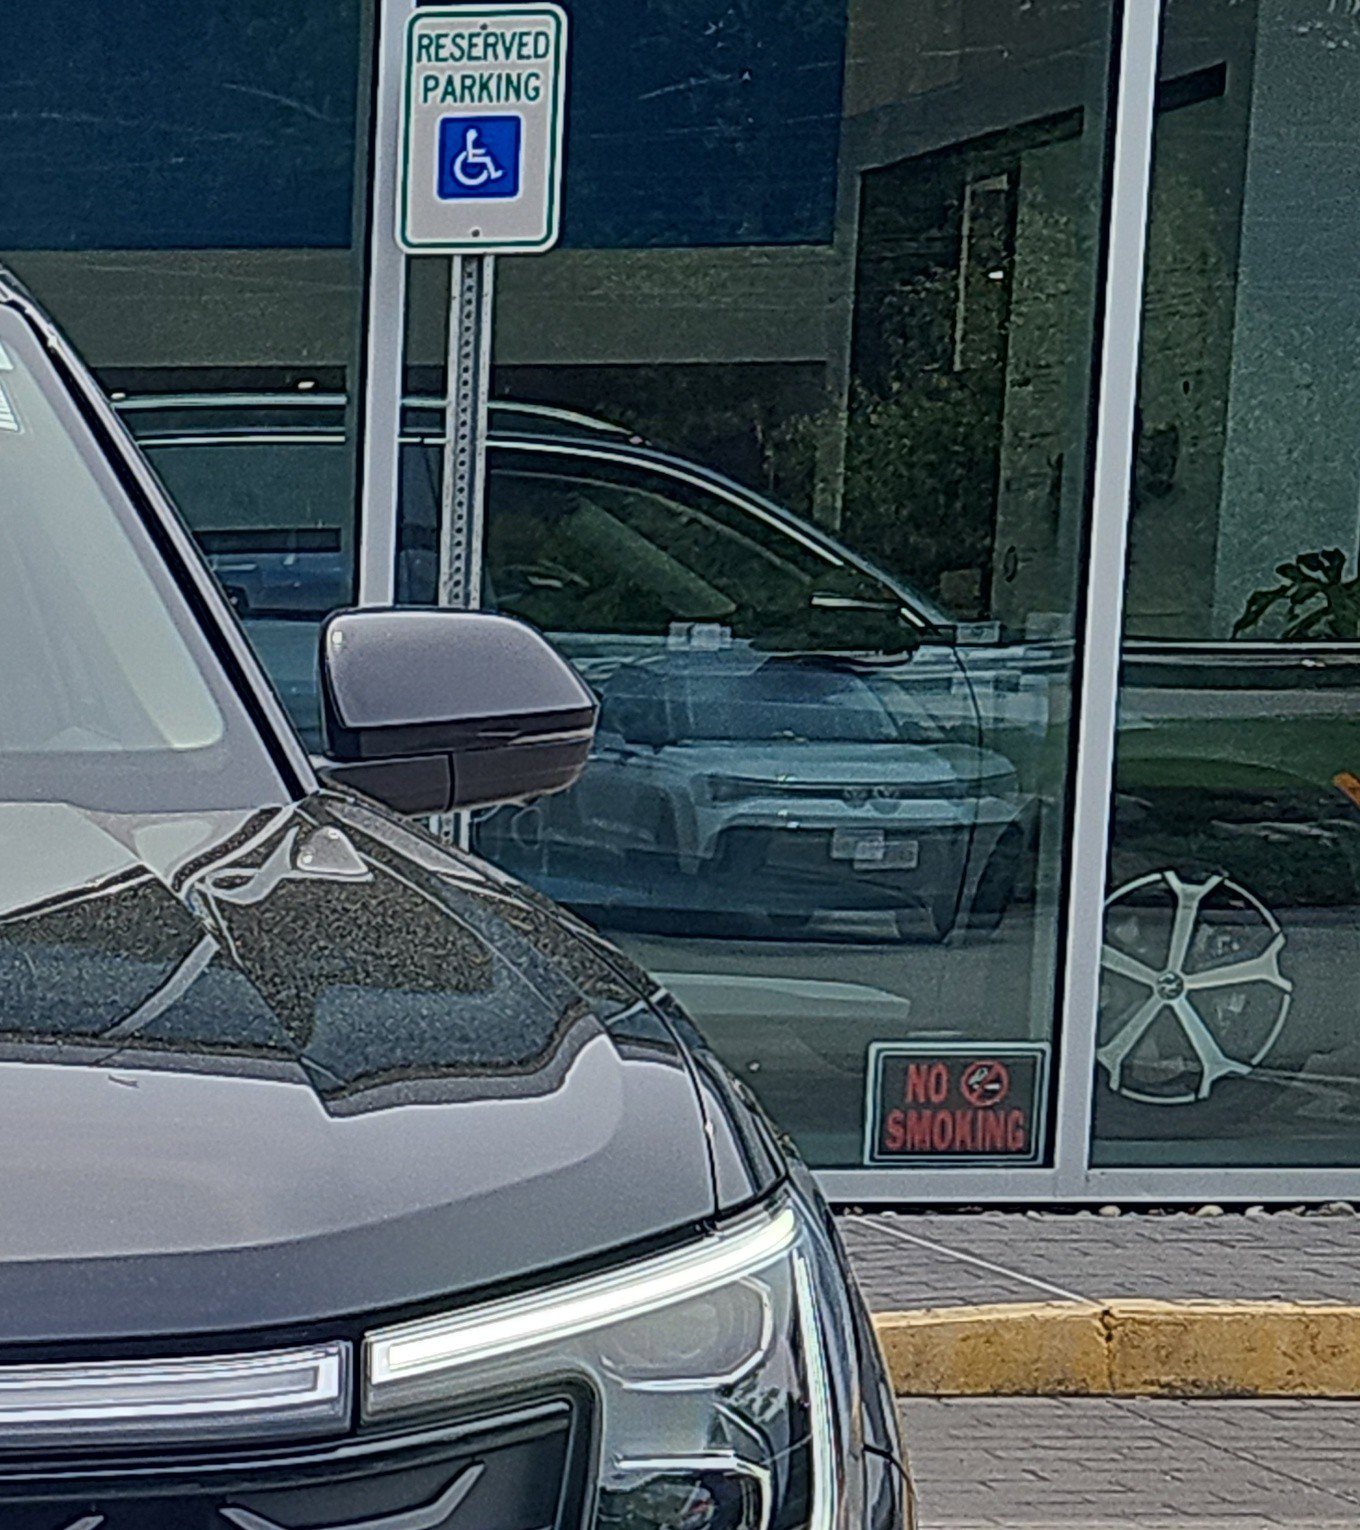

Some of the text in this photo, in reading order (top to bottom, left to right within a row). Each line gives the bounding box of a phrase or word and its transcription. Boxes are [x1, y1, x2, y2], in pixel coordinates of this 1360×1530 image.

[416, 31, 550, 63] RESERVED
[422, 72, 541, 104] PARKING
[906, 1062, 950, 1104] NO
[885, 1108, 1026, 1152] SMOKING
